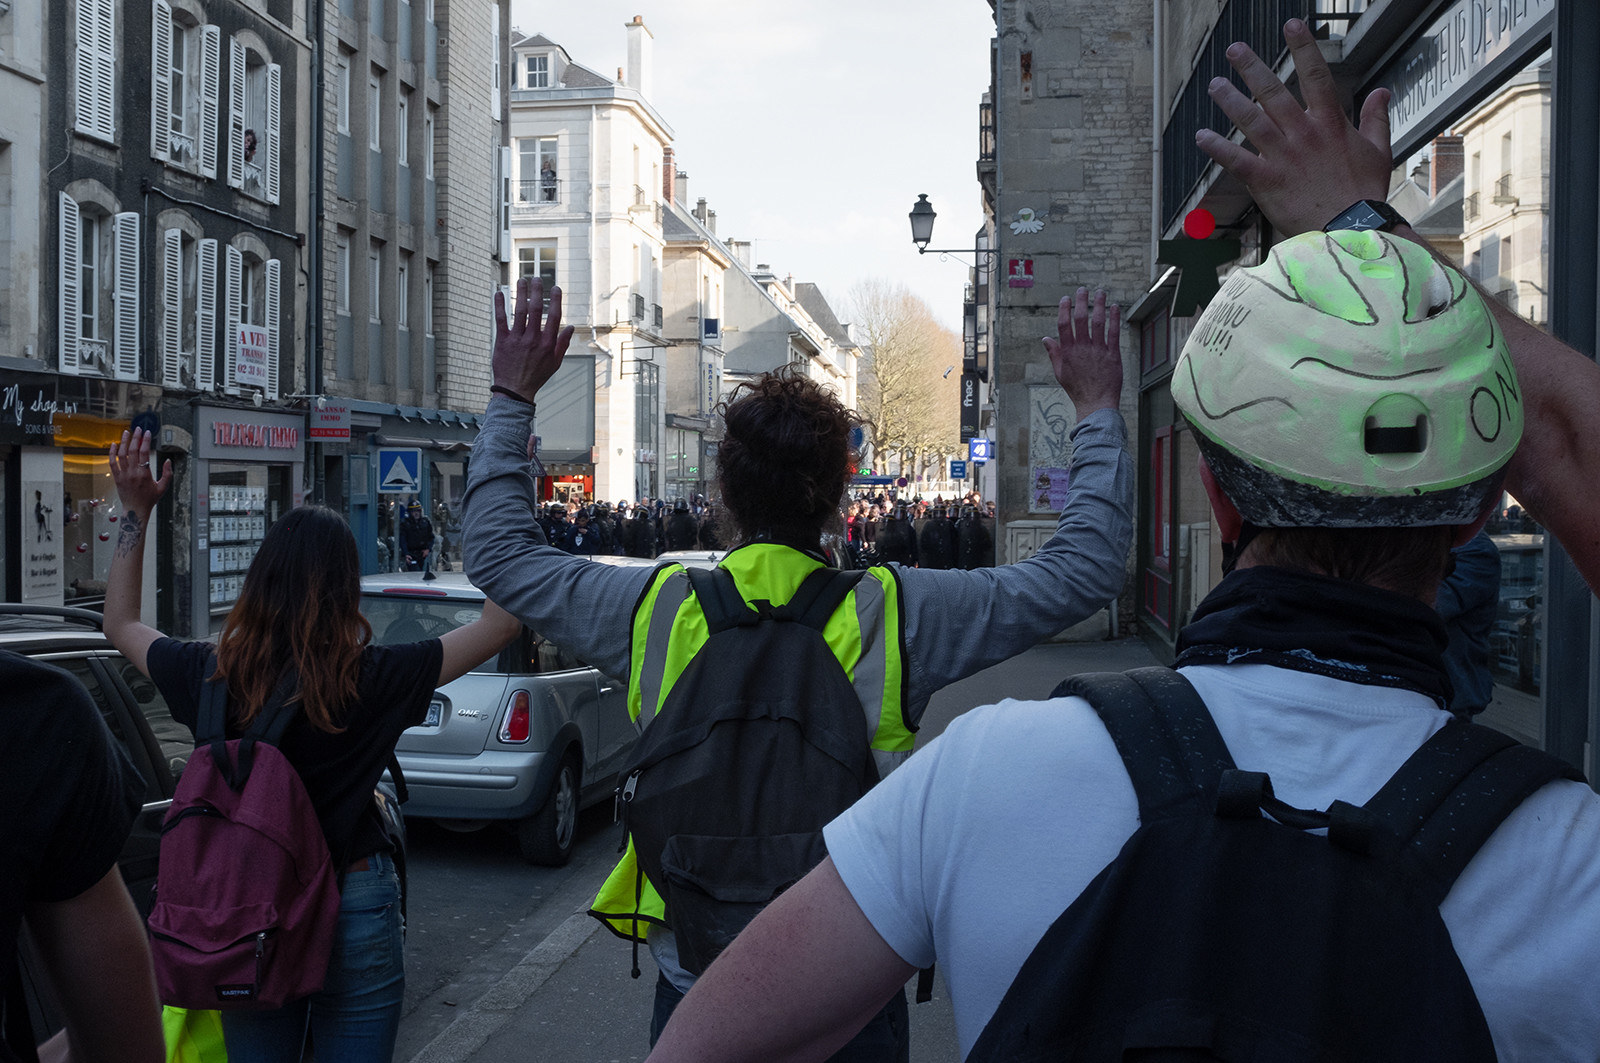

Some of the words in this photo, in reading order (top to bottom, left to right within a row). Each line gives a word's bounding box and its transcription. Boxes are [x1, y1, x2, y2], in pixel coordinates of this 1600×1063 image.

[1388, 8, 1467, 133] NISTRATEUR
[1471, 0, 1493, 63] DE
[238, 330, 247, 345] A
[3, 383, 25, 426] My
[963, 380, 974, 407] fnac
[25, 424, 40, 434] SOINS
[213, 420, 268, 448] TRANSAC
[268, 425, 299, 449] IMMO
[458, 708, 480, 718] ONE
